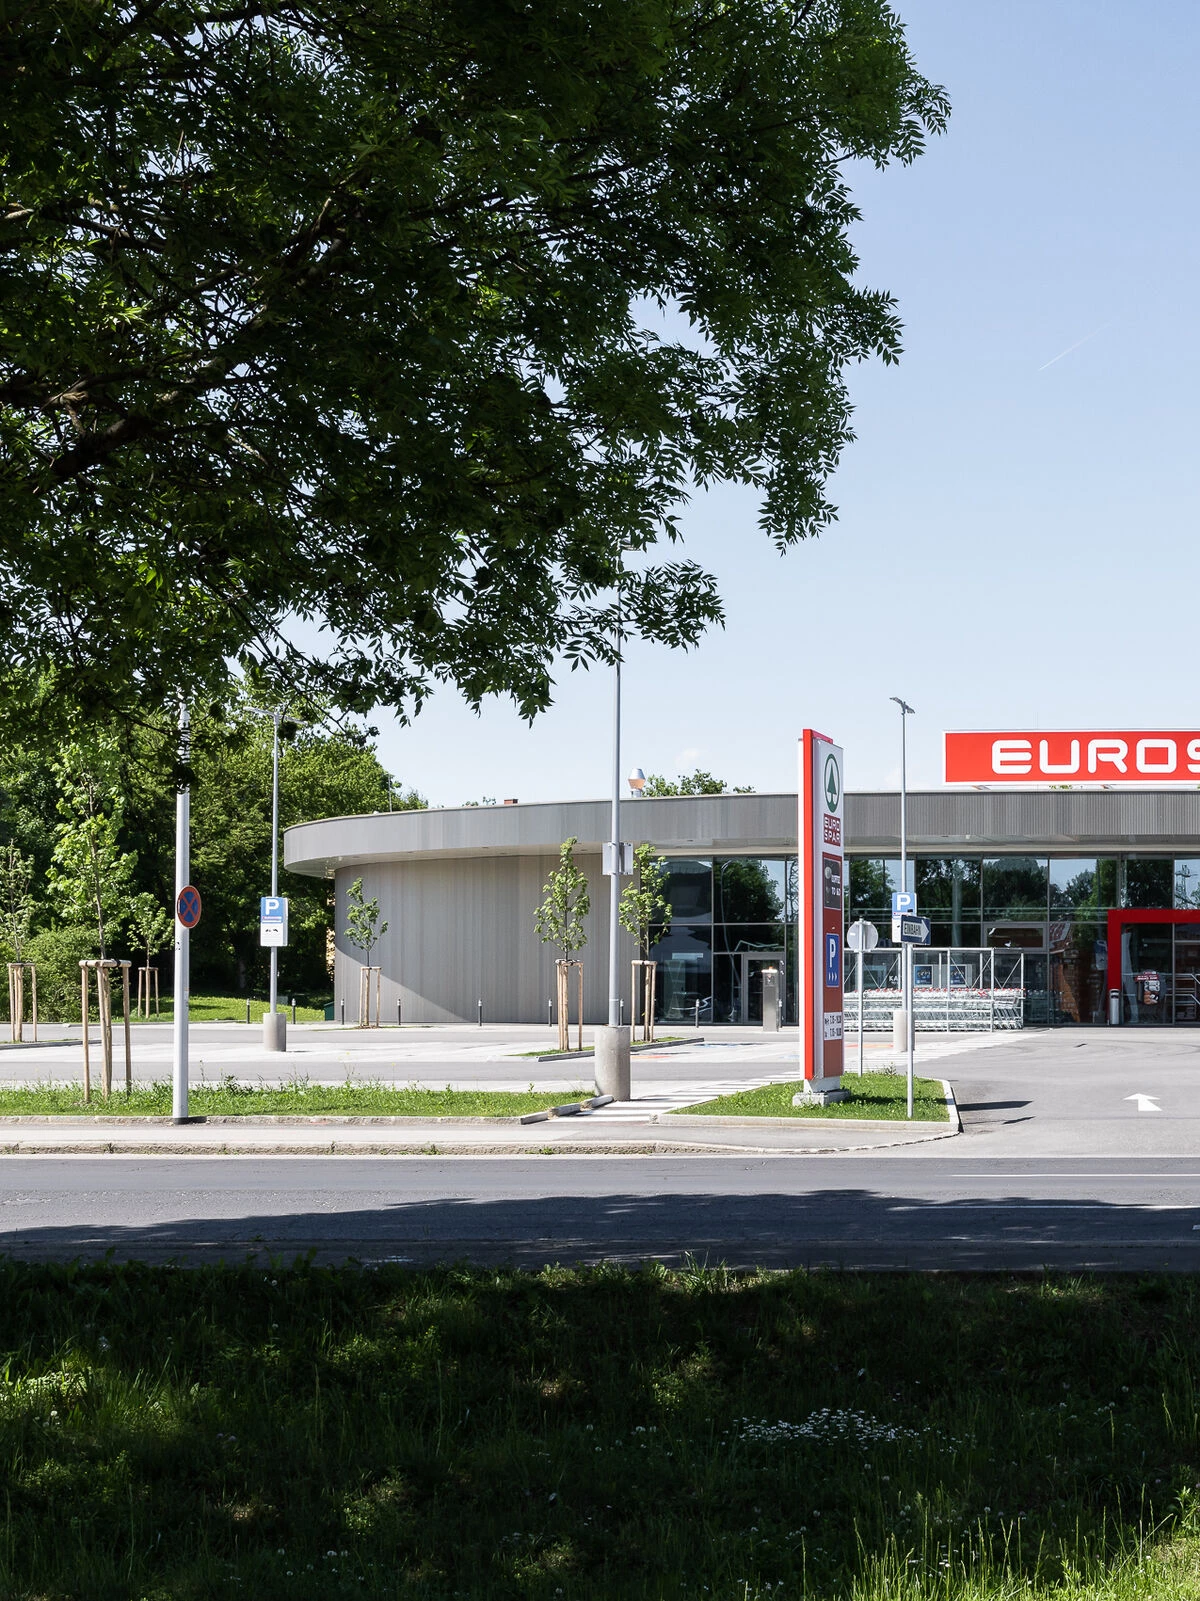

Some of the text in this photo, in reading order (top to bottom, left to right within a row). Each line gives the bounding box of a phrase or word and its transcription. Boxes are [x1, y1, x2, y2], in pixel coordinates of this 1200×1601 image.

[824, 816, 840, 832] EURO
[824, 829, 840, 843] SPAR
[265, 898, 280, 916] P
[896, 894, 911, 911] P
[904, 923, 922, 937] EINBAHN
[829, 938, 837, 968] P
